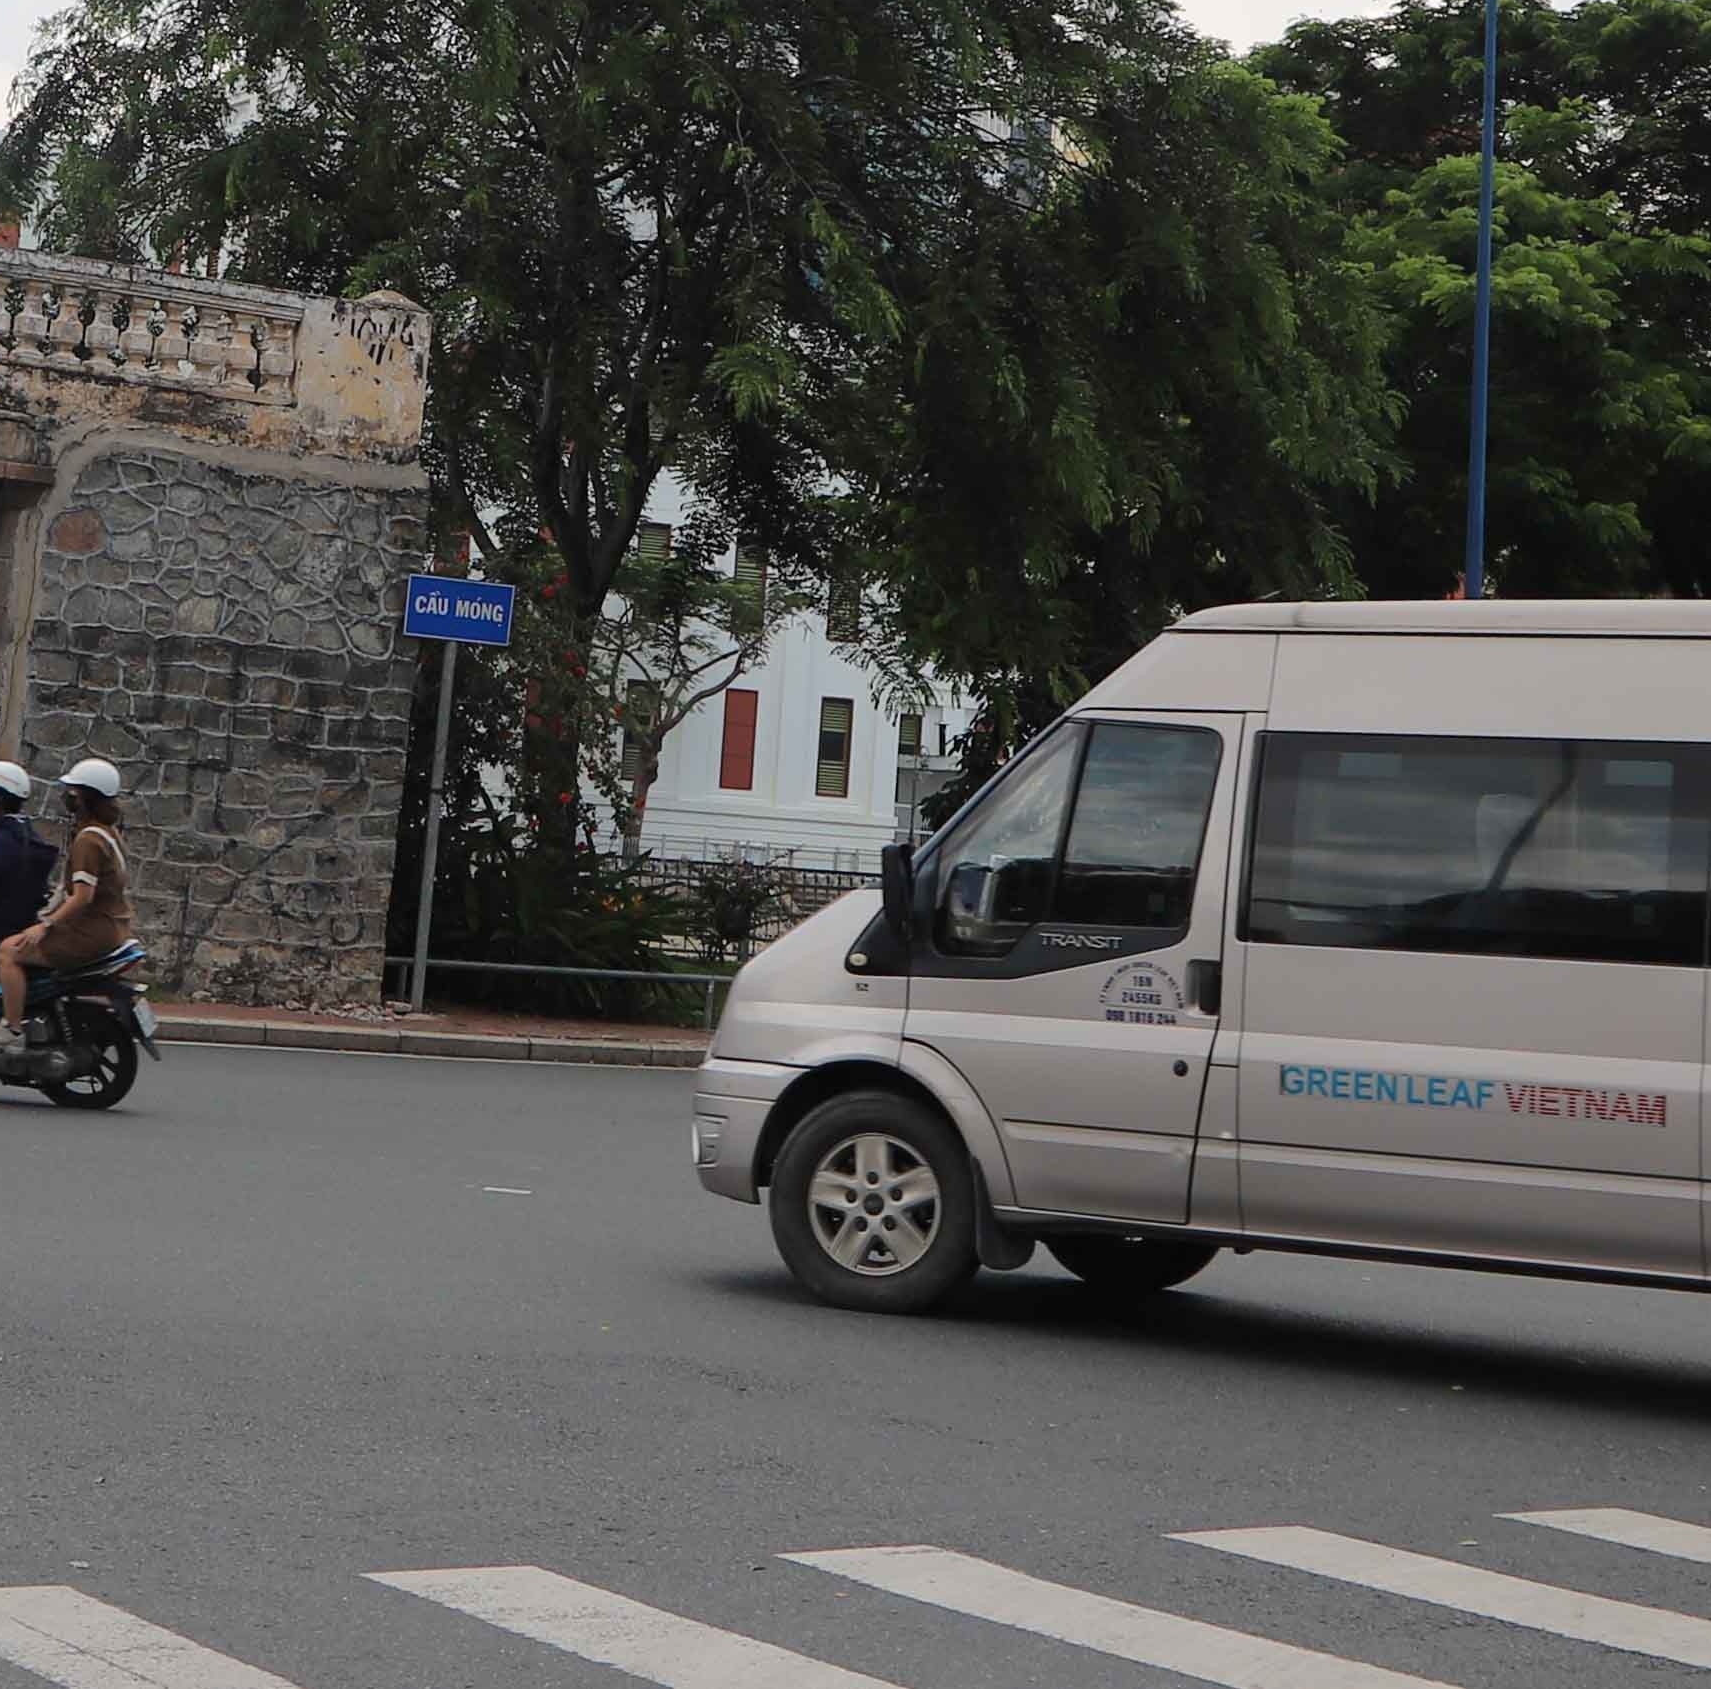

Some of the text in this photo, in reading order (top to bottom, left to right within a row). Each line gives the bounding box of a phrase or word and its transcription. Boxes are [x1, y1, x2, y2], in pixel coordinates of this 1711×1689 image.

[415, 591, 448, 615] CẦU
[1039, 933, 1122, 949] TRANSIT
[1281, 1065, 1667, 1128] GREEN LEAF VIETNAM
